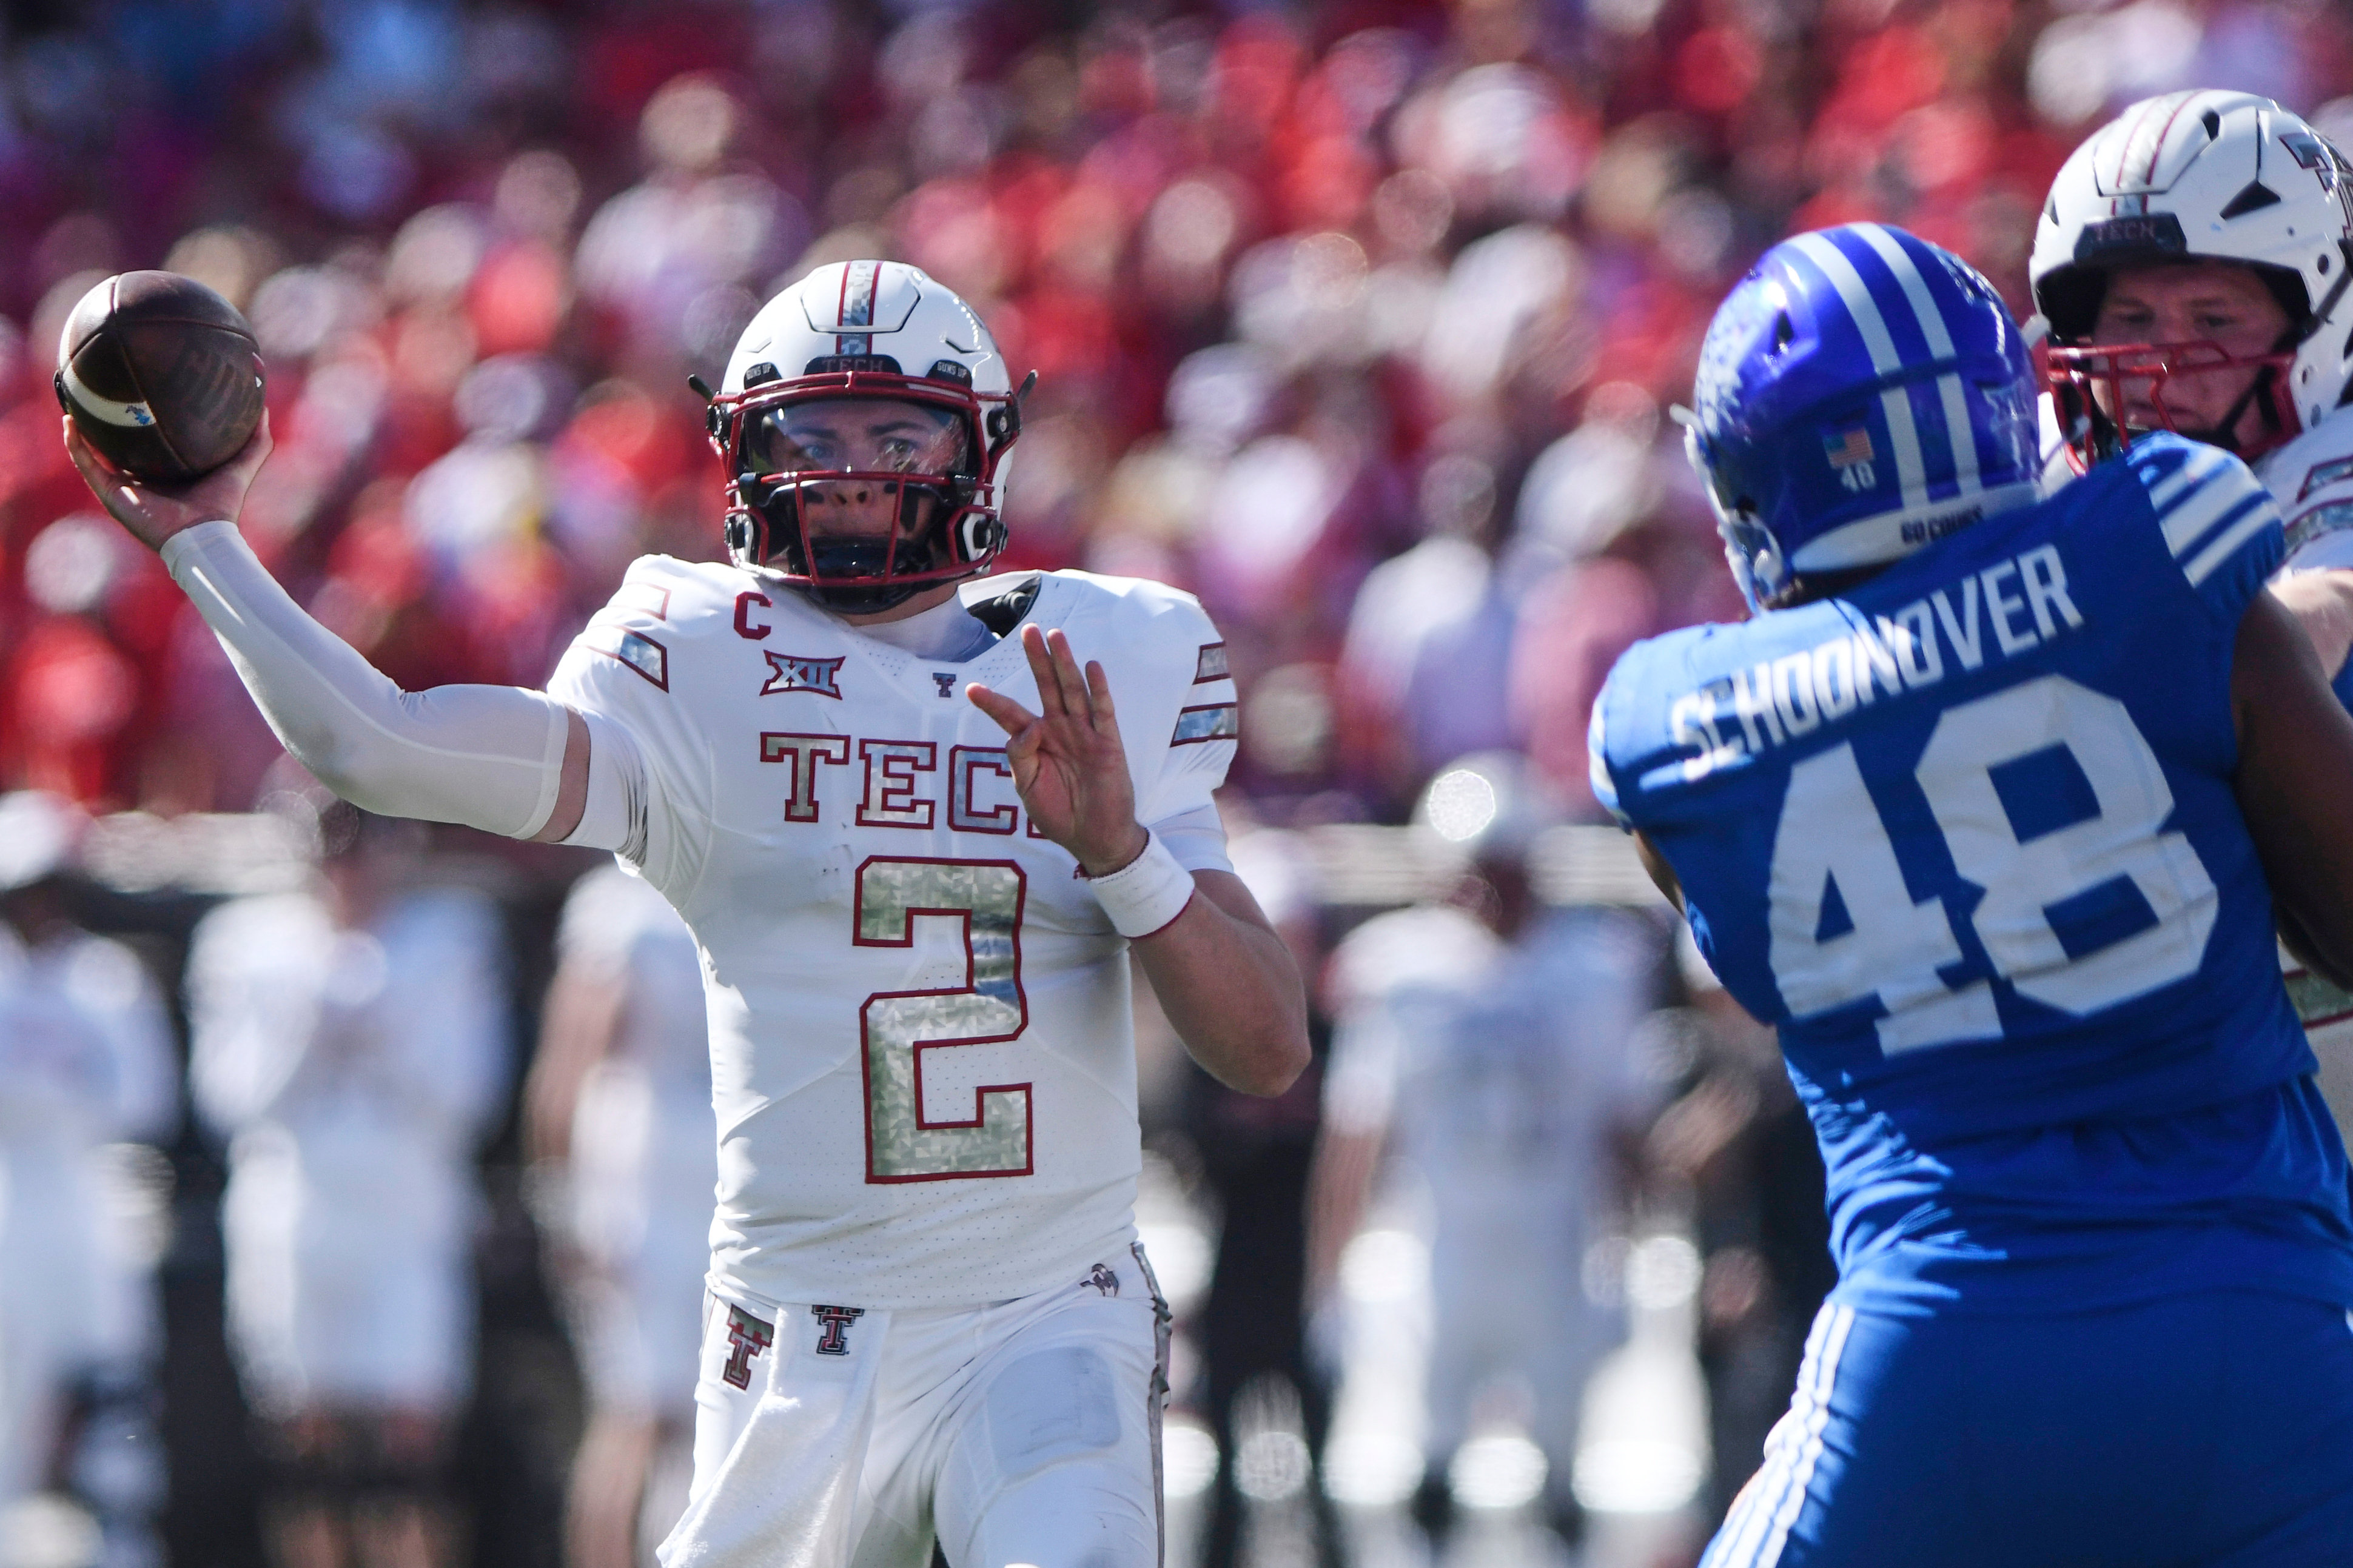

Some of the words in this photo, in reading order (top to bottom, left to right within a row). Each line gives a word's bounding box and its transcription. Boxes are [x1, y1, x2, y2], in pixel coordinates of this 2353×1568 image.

[2094, 221, 2155, 242] TECH
[746, 367, 762, 380] GUNS
[763, 364, 772, 374] UP
[825, 358, 883, 372] TECH
[937, 361, 956, 374] GUNS
[957, 368, 968, 379] UP
[734, 591, 772, 640] C
[759, 649, 846, 700] XII
[1671, 544, 2084, 765] SCHOONOVER
[760, 732, 1049, 839] TEC
[1769, 674, 2218, 1057] 48
[853, 855, 1033, 1184] 2
